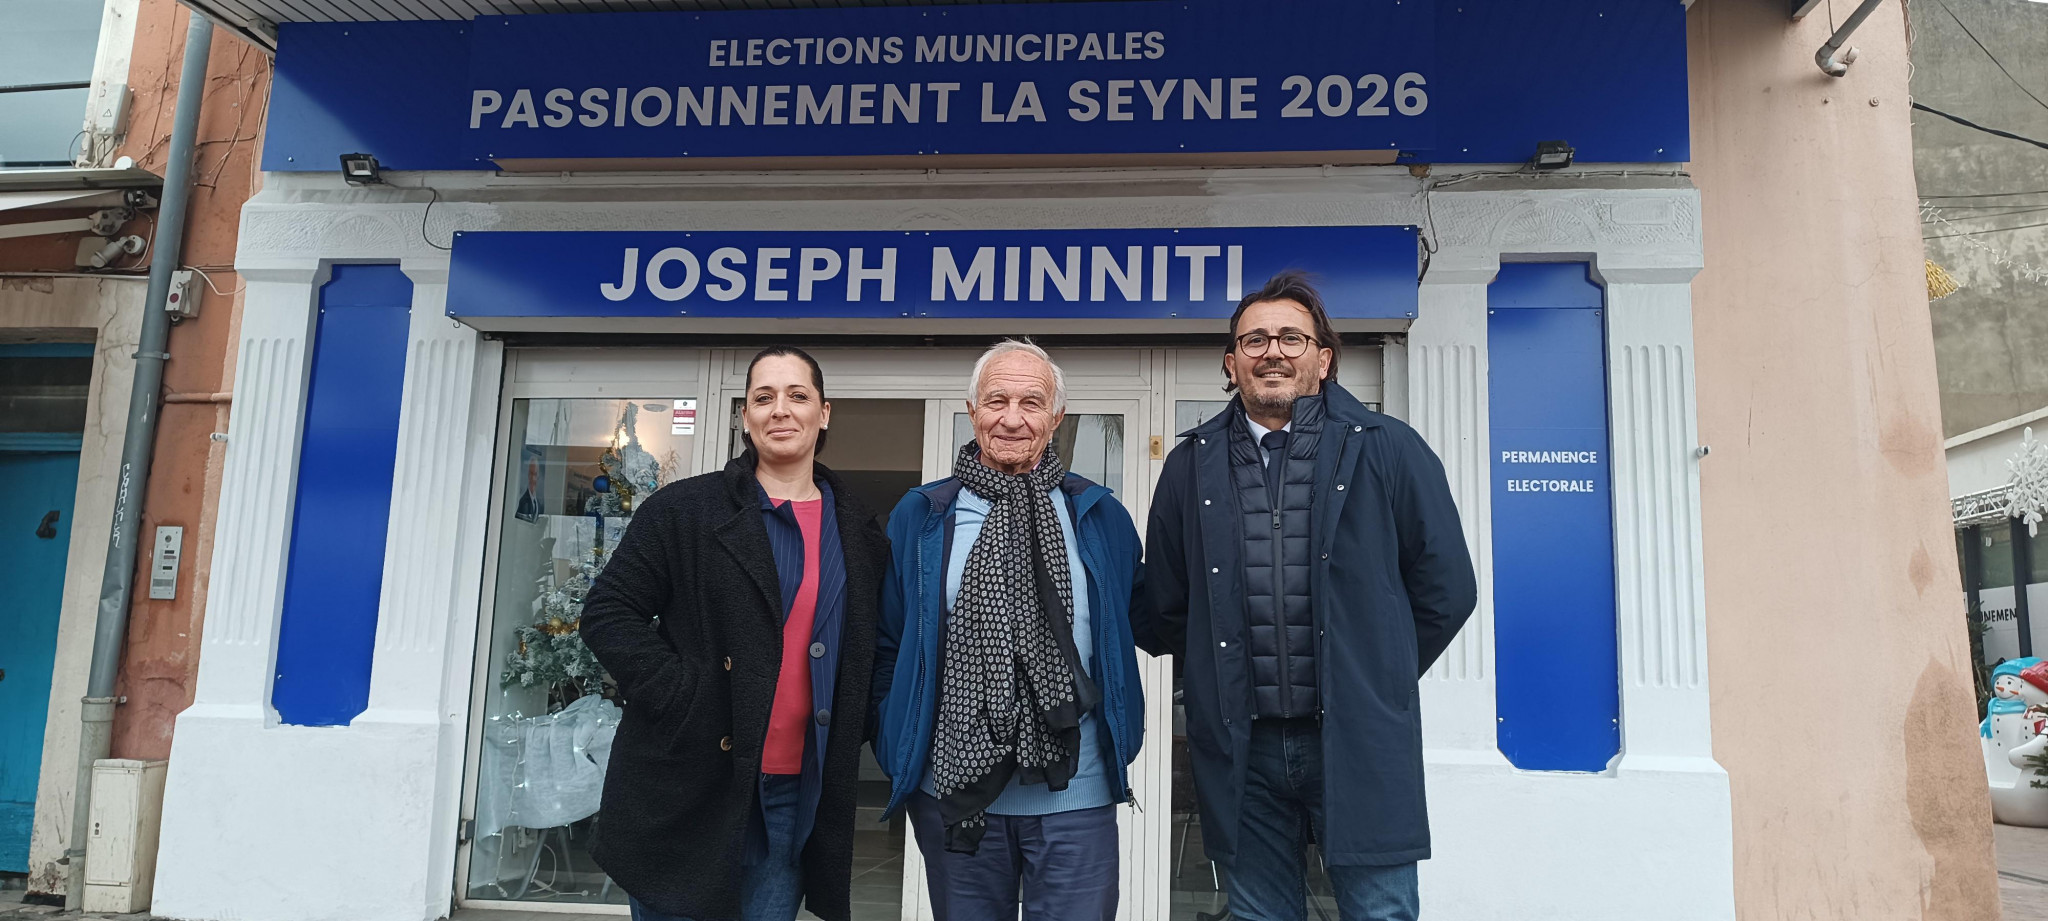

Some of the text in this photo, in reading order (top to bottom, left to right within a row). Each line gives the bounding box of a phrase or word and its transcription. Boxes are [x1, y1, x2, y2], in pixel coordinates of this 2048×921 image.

[709, 31, 1165, 66] ELECTIONS MUNICIPALES
[470, 72, 1428, 128] PASSIONNEMENT LA SEYNE 2026
[600, 245, 1243, 301] JOSEPH MINNITI
[1502, 451, 1597, 463] PERMANENCE
[1507, 480, 1594, 492] ELECTORALE
